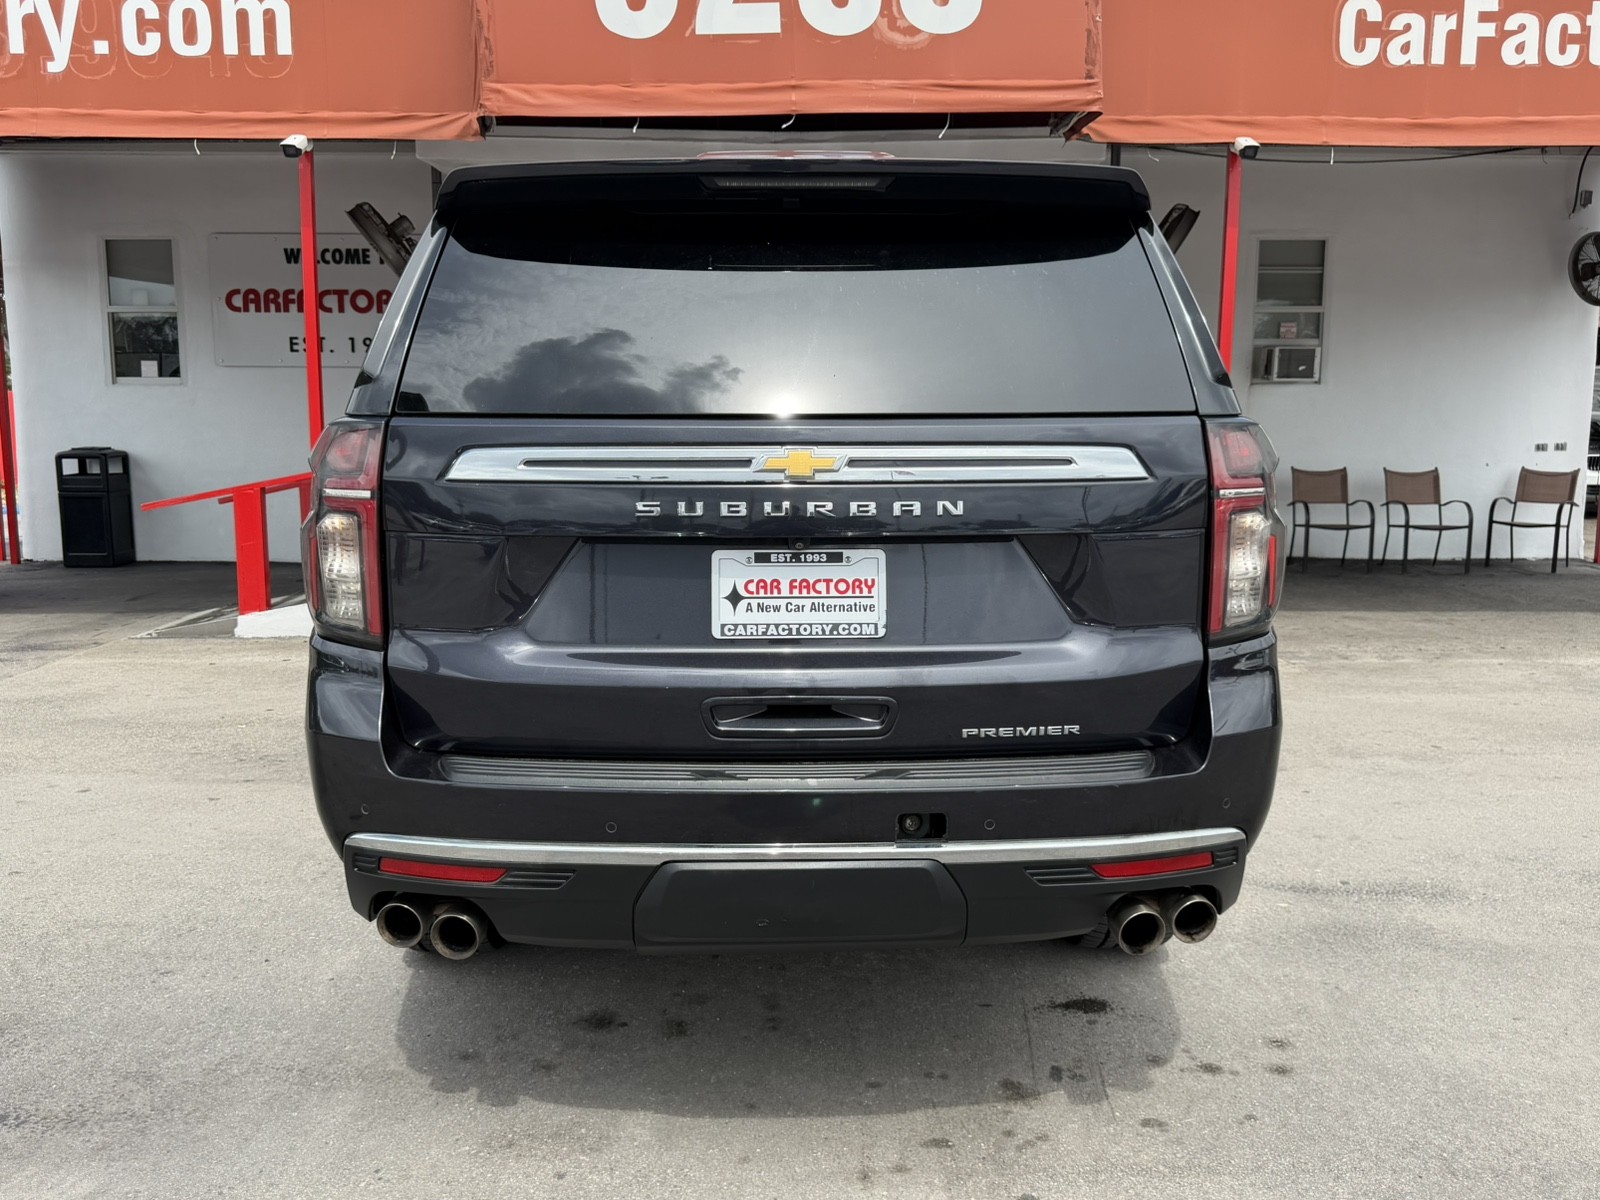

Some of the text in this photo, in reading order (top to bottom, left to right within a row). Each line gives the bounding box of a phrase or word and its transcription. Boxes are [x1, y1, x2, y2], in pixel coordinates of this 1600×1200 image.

[284, 247, 371, 265] WCOME
[635, 500, 964, 517] SUBURBAN
[770, 552, 827, 563] EST. 1993
[743, 578, 876, 595] CAR FACTORY
[745, 601, 876, 613] A New Car Alternative
[723, 624, 876, 636] CARFACTORY.COM
[961, 725, 1080, 738] PREMIER
